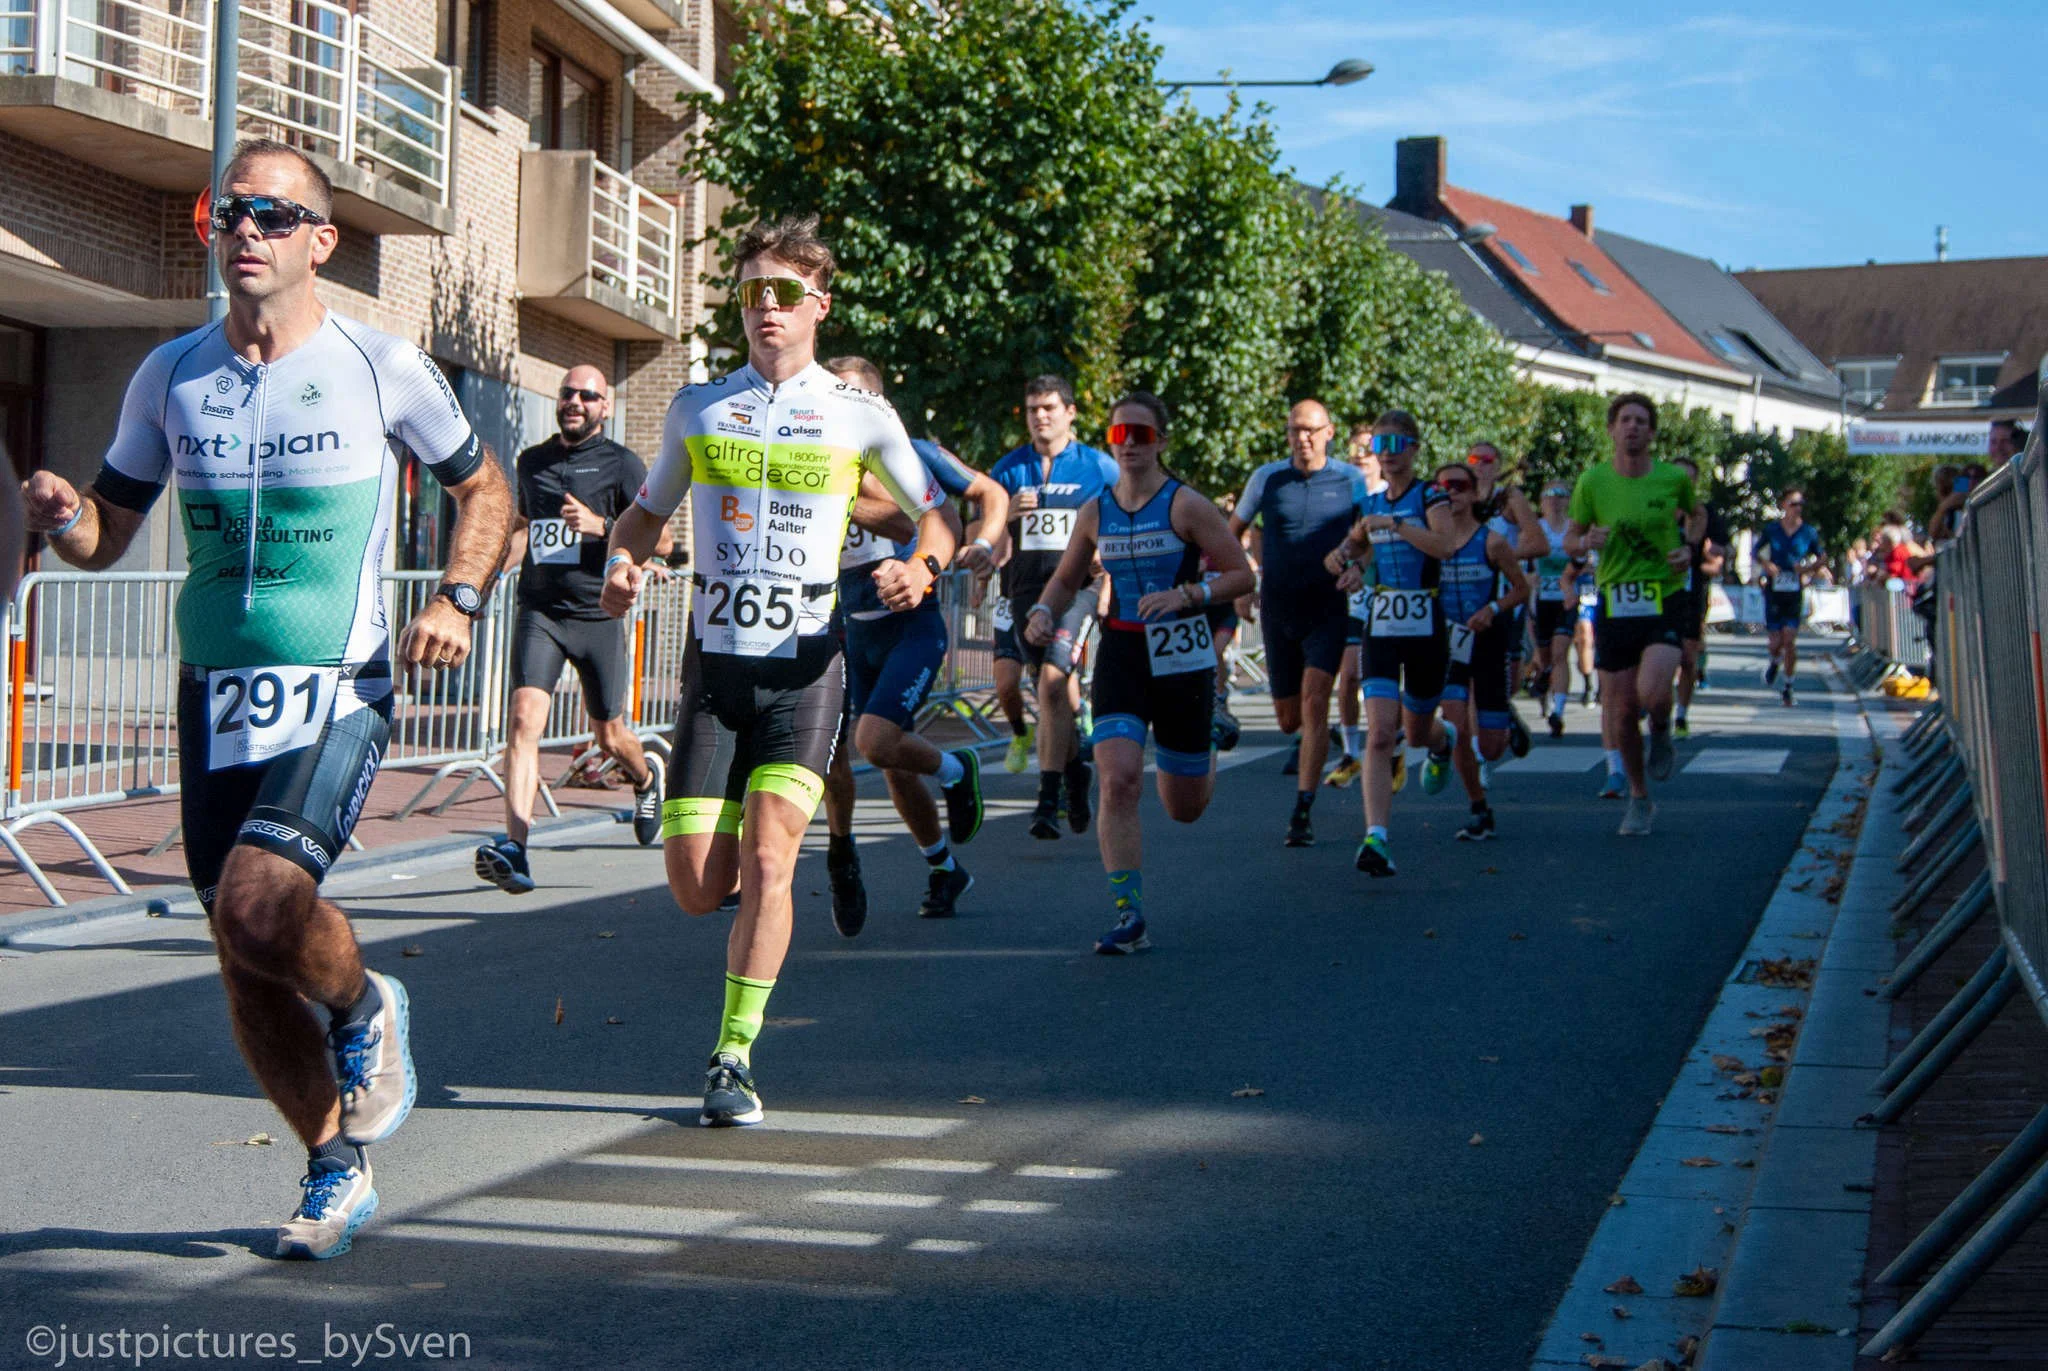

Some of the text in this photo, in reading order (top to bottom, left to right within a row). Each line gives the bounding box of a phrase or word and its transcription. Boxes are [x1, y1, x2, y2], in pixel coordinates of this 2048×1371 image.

[178, 433, 229, 458] nxt
[1906, 431, 1987, 446] AANKOMST
[704, 441, 764, 464] altra
[745, 467, 830, 488] decor
[769, 501, 812, 519] Botha
[532, 522, 576, 548] 280
[768, 519, 806, 535] Aalter
[1026, 513, 1068, 536] 281
[716, 536, 806, 567] sy-bo
[1611, 580, 1658, 603] 195
[707, 581, 794, 631] 265
[1376, 594, 1428, 620] 203
[1151, 620, 1210, 658] 238
[215, 672, 322, 735] 291
